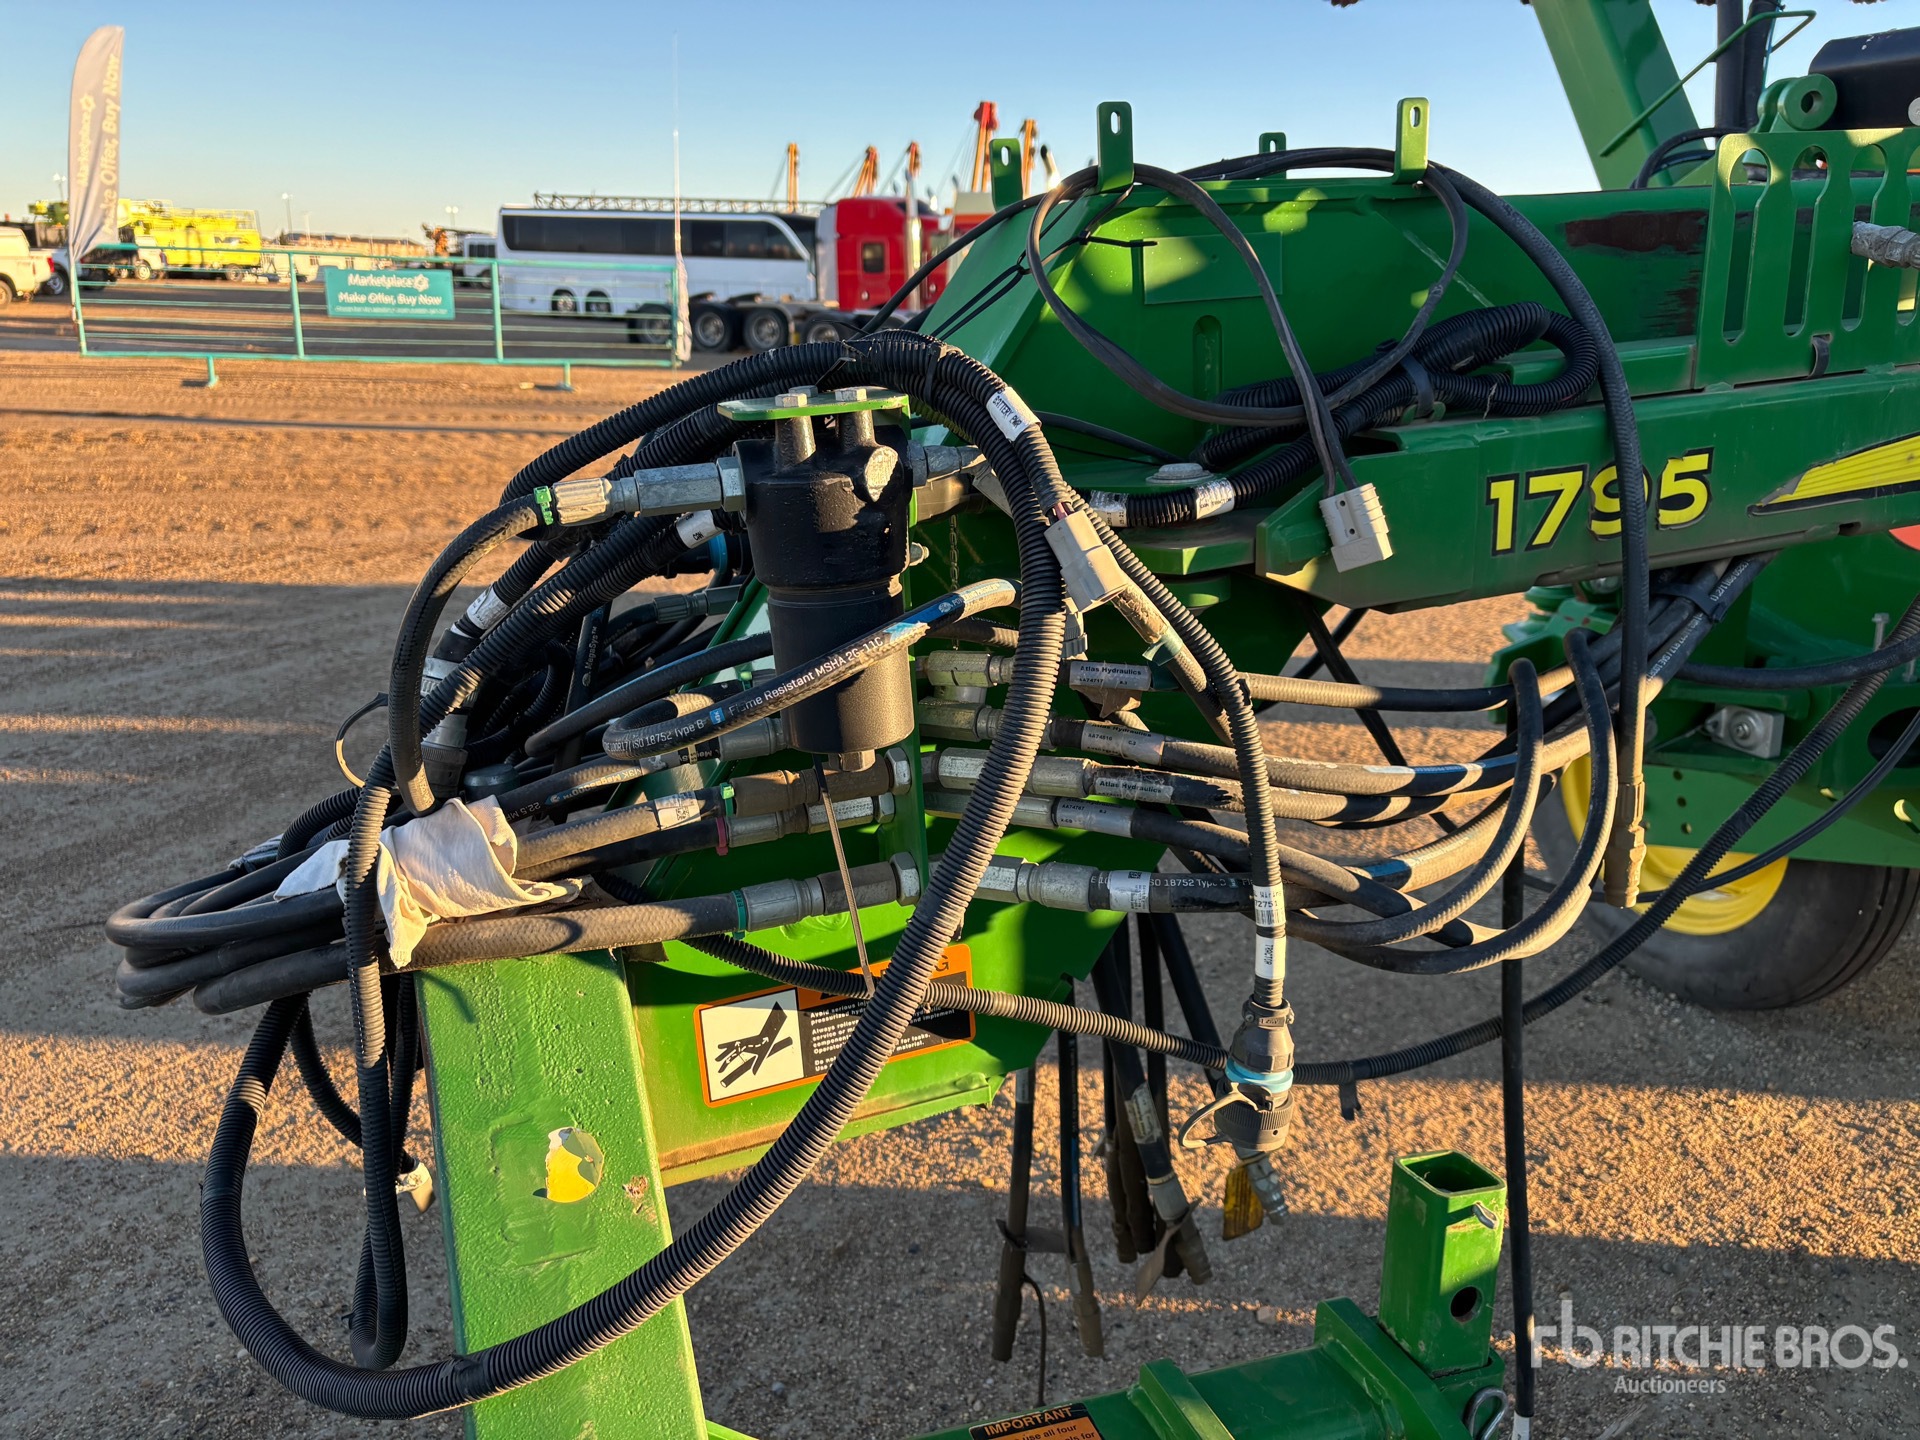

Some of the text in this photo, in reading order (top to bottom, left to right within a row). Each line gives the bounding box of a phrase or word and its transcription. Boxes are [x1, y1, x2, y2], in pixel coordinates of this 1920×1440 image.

[103, 53, 121, 96] Now
[102, 98, 121, 136] Buy
[100, 138, 119, 187] Offer,
[347, 273, 414, 289] Marketplace
[338, 291, 443, 307] Make Offer, Buy Now
[992, 395, 1014, 418] BATTERY
[1485, 447, 1715, 557] 1795
[1080, 665, 1142, 676] Atlas Hydraulics
[645, 731, 673, 746] 18752
[763, 671, 815, 701] Resistant
[814, 657, 847, 678] MSHA
[845, 636, 884, 661] 2G-11C
[1099, 780, 1162, 794] Atlas Hydraulics
[520, 801, 541, 816] 22.5
[1163, 878, 1195, 887] 18752
[810, 1008, 830, 1019] Avoid
[831, 1004, 856, 1015] serious
[922, 1010, 956, 1022] implement
[810, 1012, 850, 1026] pressurized
[811, 1025, 834, 1036] Always
[812, 1031, 838, 1042] service
[838, 1029, 846, 1037] or
[896, 1040, 925, 1052] material.
[900, 1036, 912, 1045] for
[814, 1056, 837, 1066] Do not
[815, 1064, 829, 1072] Use
[984, 1406, 1072, 1436] IMPORTANT
[1043, 1430, 1056, 1439] all
[1057, 1424, 1077, 1435] four
[1081, 1432, 1096, 1440] for
